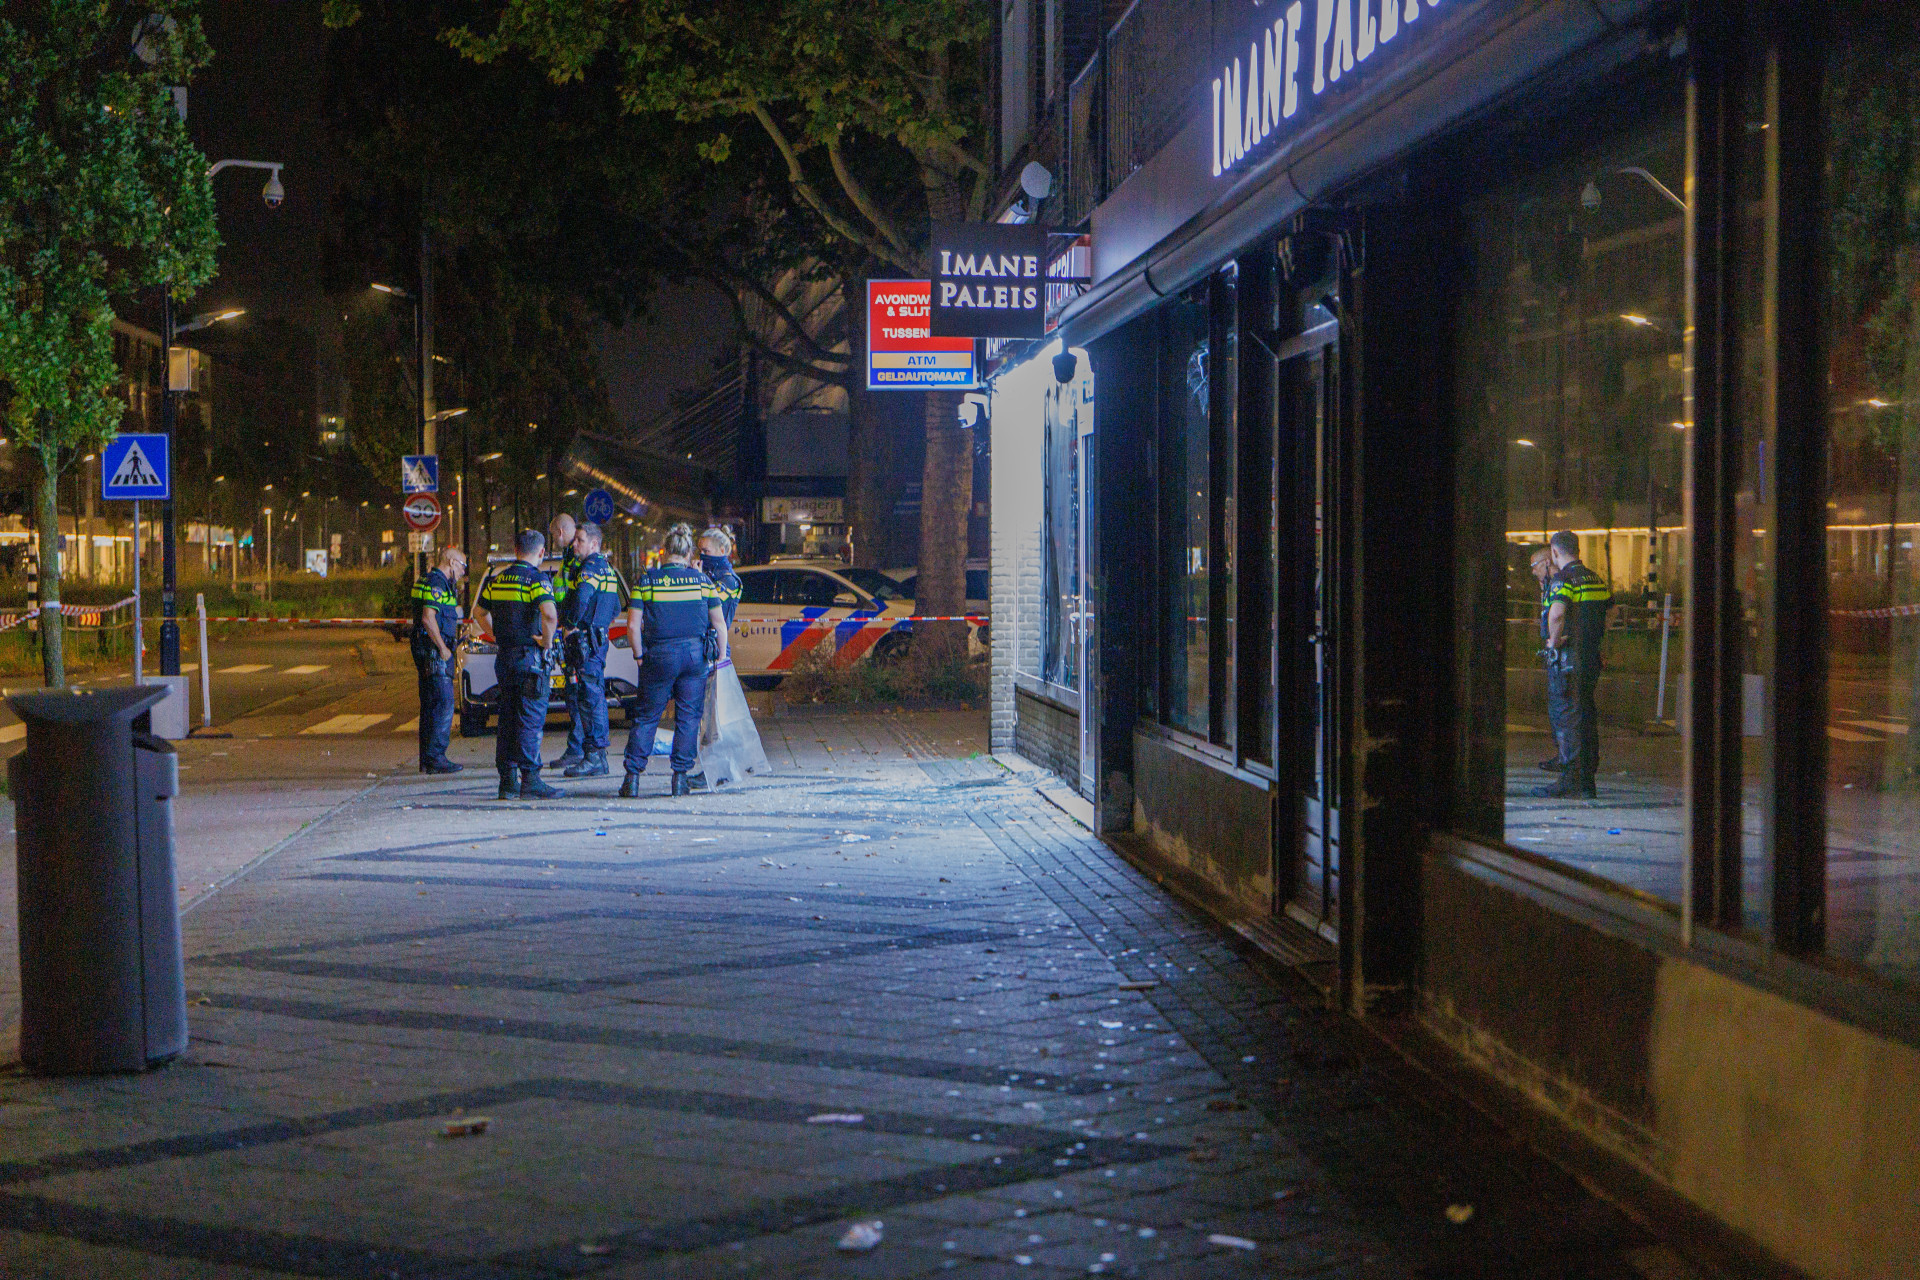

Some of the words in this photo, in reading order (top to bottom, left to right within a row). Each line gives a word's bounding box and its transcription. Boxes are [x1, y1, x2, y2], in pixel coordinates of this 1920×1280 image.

[1212, 0, 1301, 177] IMANE
[940, 250, 1038, 277] IMANE
[940, 282, 1038, 309] PALEIS
[886, 306, 896, 317] &
[907, 356, 936, 366] ATM
[877, 372, 967, 382] GELDAUTOMAAT
